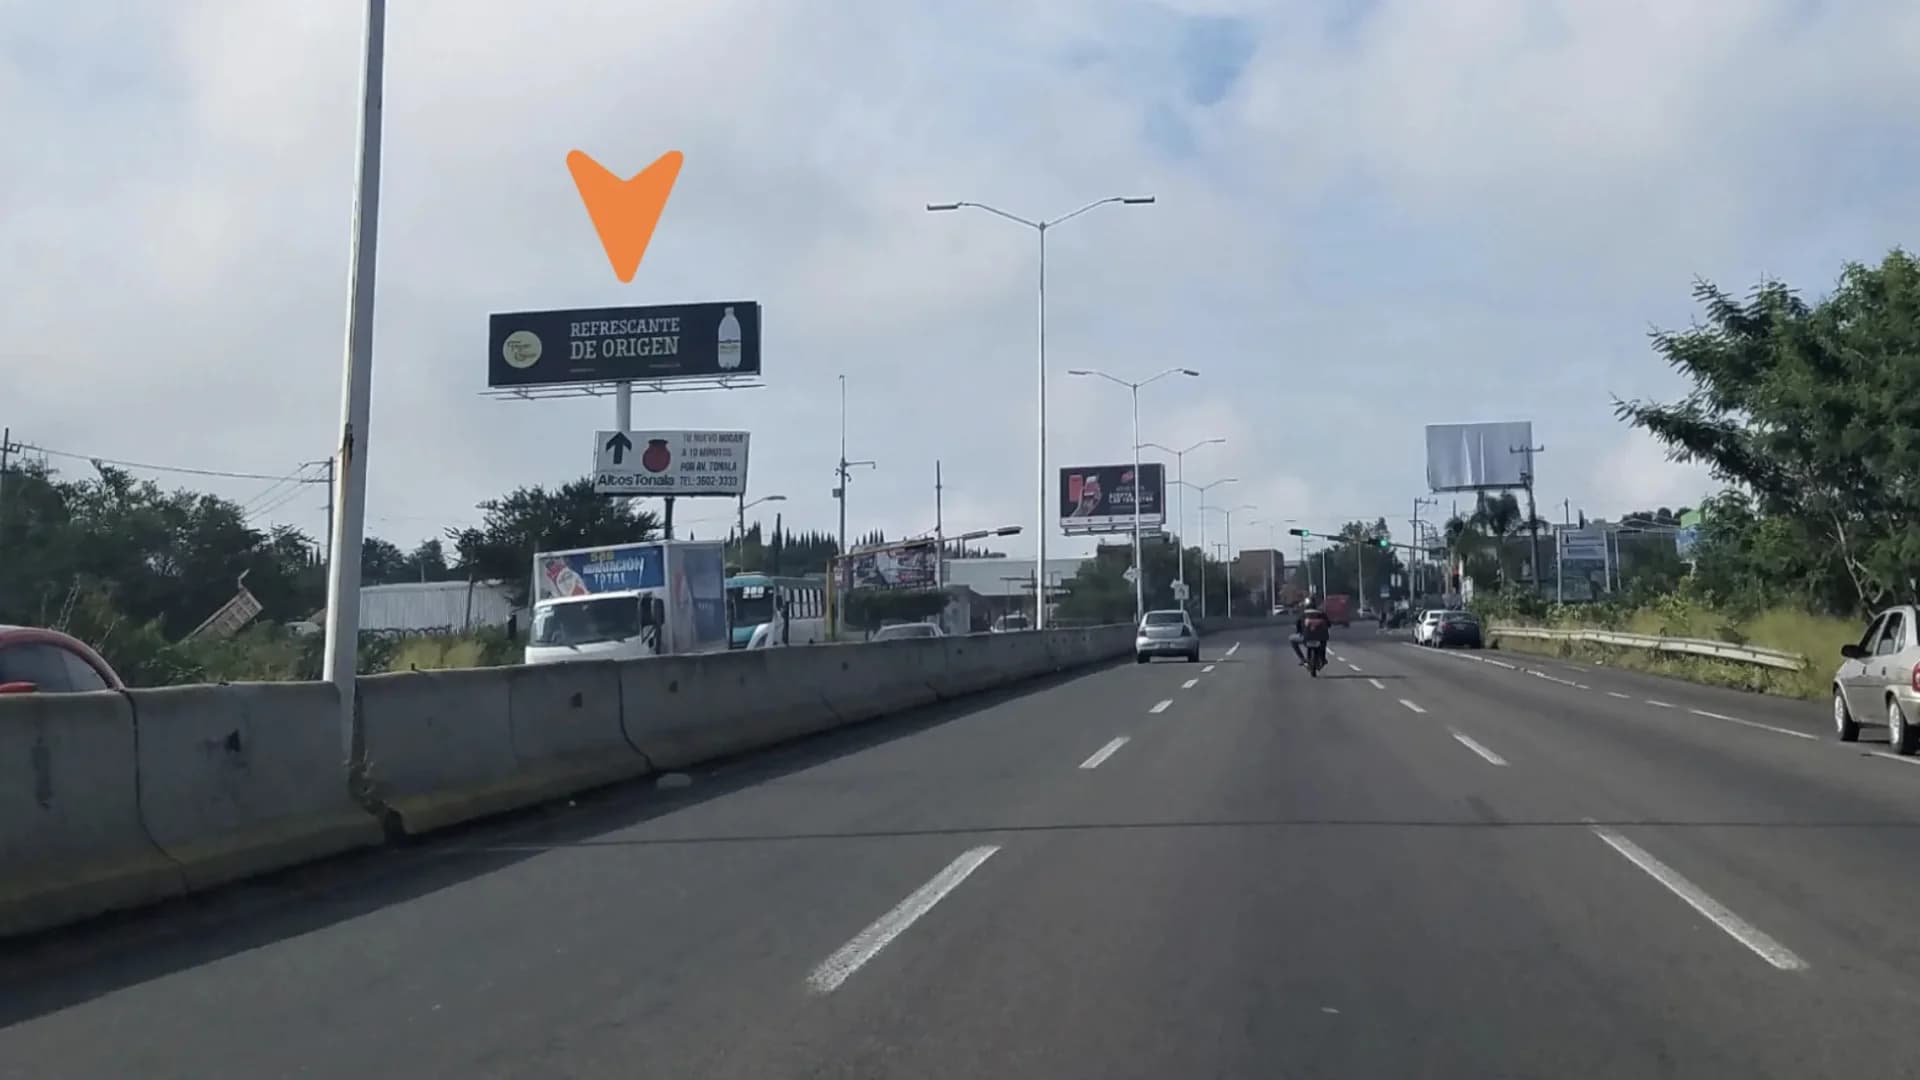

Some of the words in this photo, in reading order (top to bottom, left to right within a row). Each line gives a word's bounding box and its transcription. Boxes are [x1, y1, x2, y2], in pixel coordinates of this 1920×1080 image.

[570, 317, 681, 337] REFRESCANTE
[570, 340, 598, 360] DE
[602, 336, 680, 359] ORIGEN
[680, 461, 695, 471] POR
